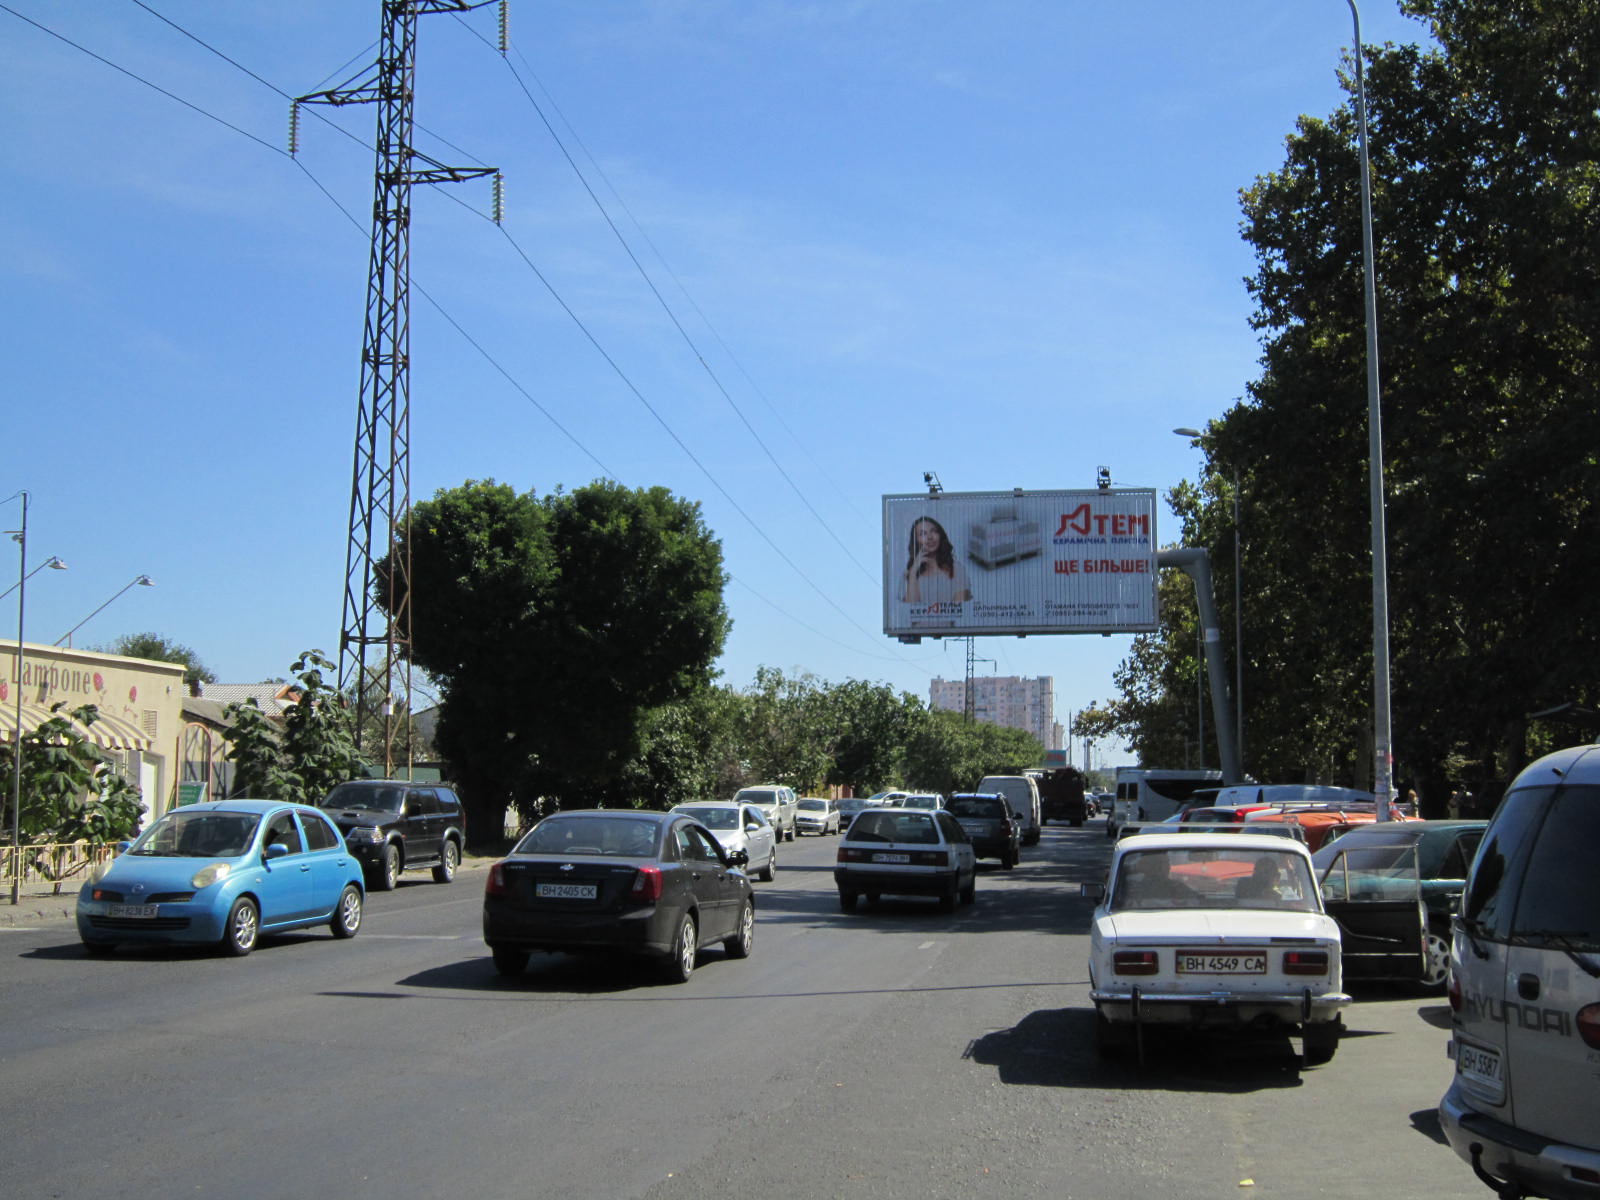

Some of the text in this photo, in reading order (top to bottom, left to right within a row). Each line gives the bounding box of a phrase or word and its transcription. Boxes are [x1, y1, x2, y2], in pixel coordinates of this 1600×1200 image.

[1053, 537, 1149, 545] КЕРАМІЧНА ПЛИТКА
[1054, 559, 1149, 576] ЩЕ БІЛЬШЕ!
[11, 653, 91, 695] Lampone
[542, 885, 594, 897] BH 2405 CK
[1186, 957, 1264, 971] BH 4549 CA
[1464, 1048, 1477, 1070] BH
[1477, 1051, 1498, 1077] 5587
